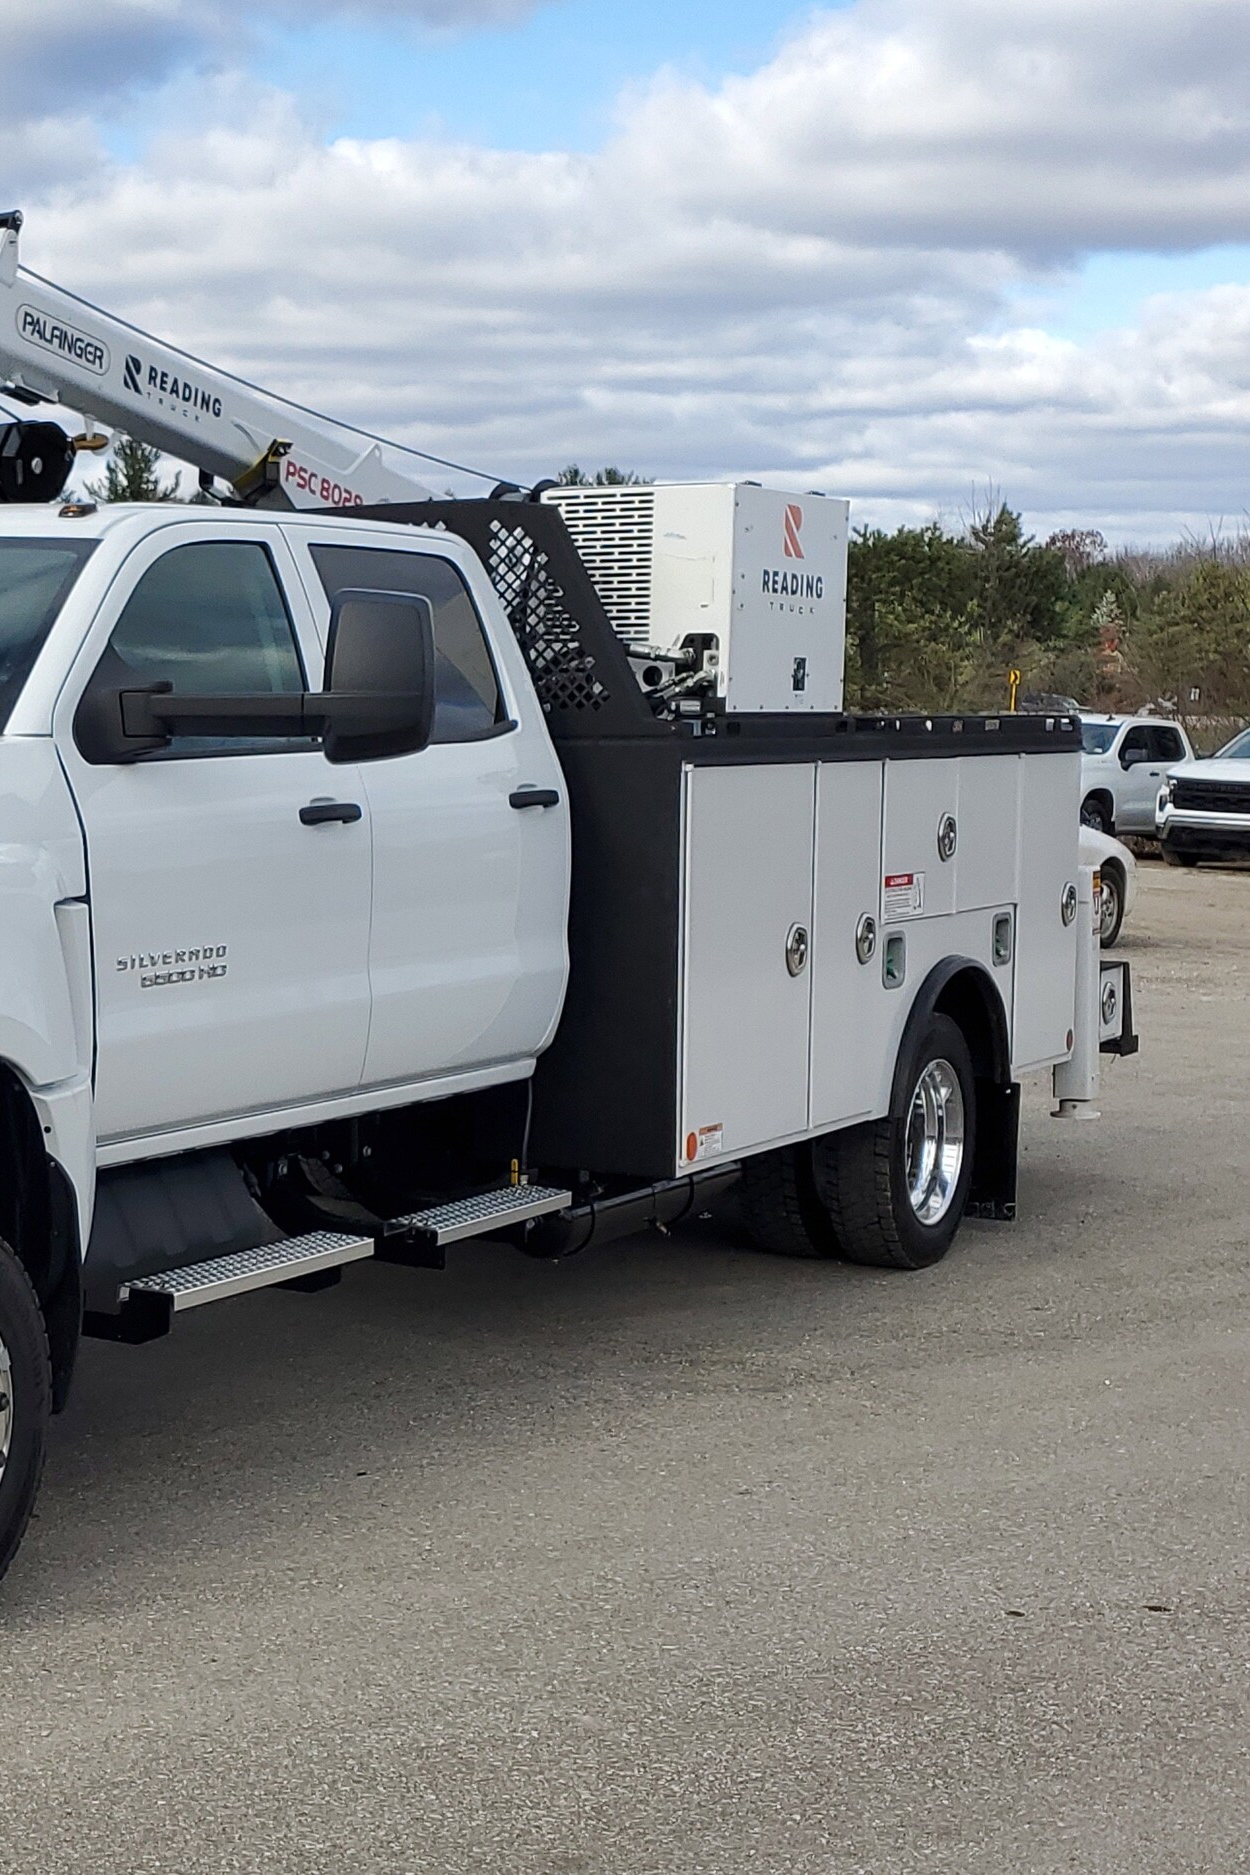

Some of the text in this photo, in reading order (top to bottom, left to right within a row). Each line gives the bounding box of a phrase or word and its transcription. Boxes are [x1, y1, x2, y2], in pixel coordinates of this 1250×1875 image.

[22, 311, 104, 369] PALFINGER
[148, 365, 223, 417] READING
[285, 460, 318, 495] PSC
[762, 569, 824, 599] READING
[769, 602, 814, 614] TRUCK
[116, 944, 227, 971] SILVERADO
